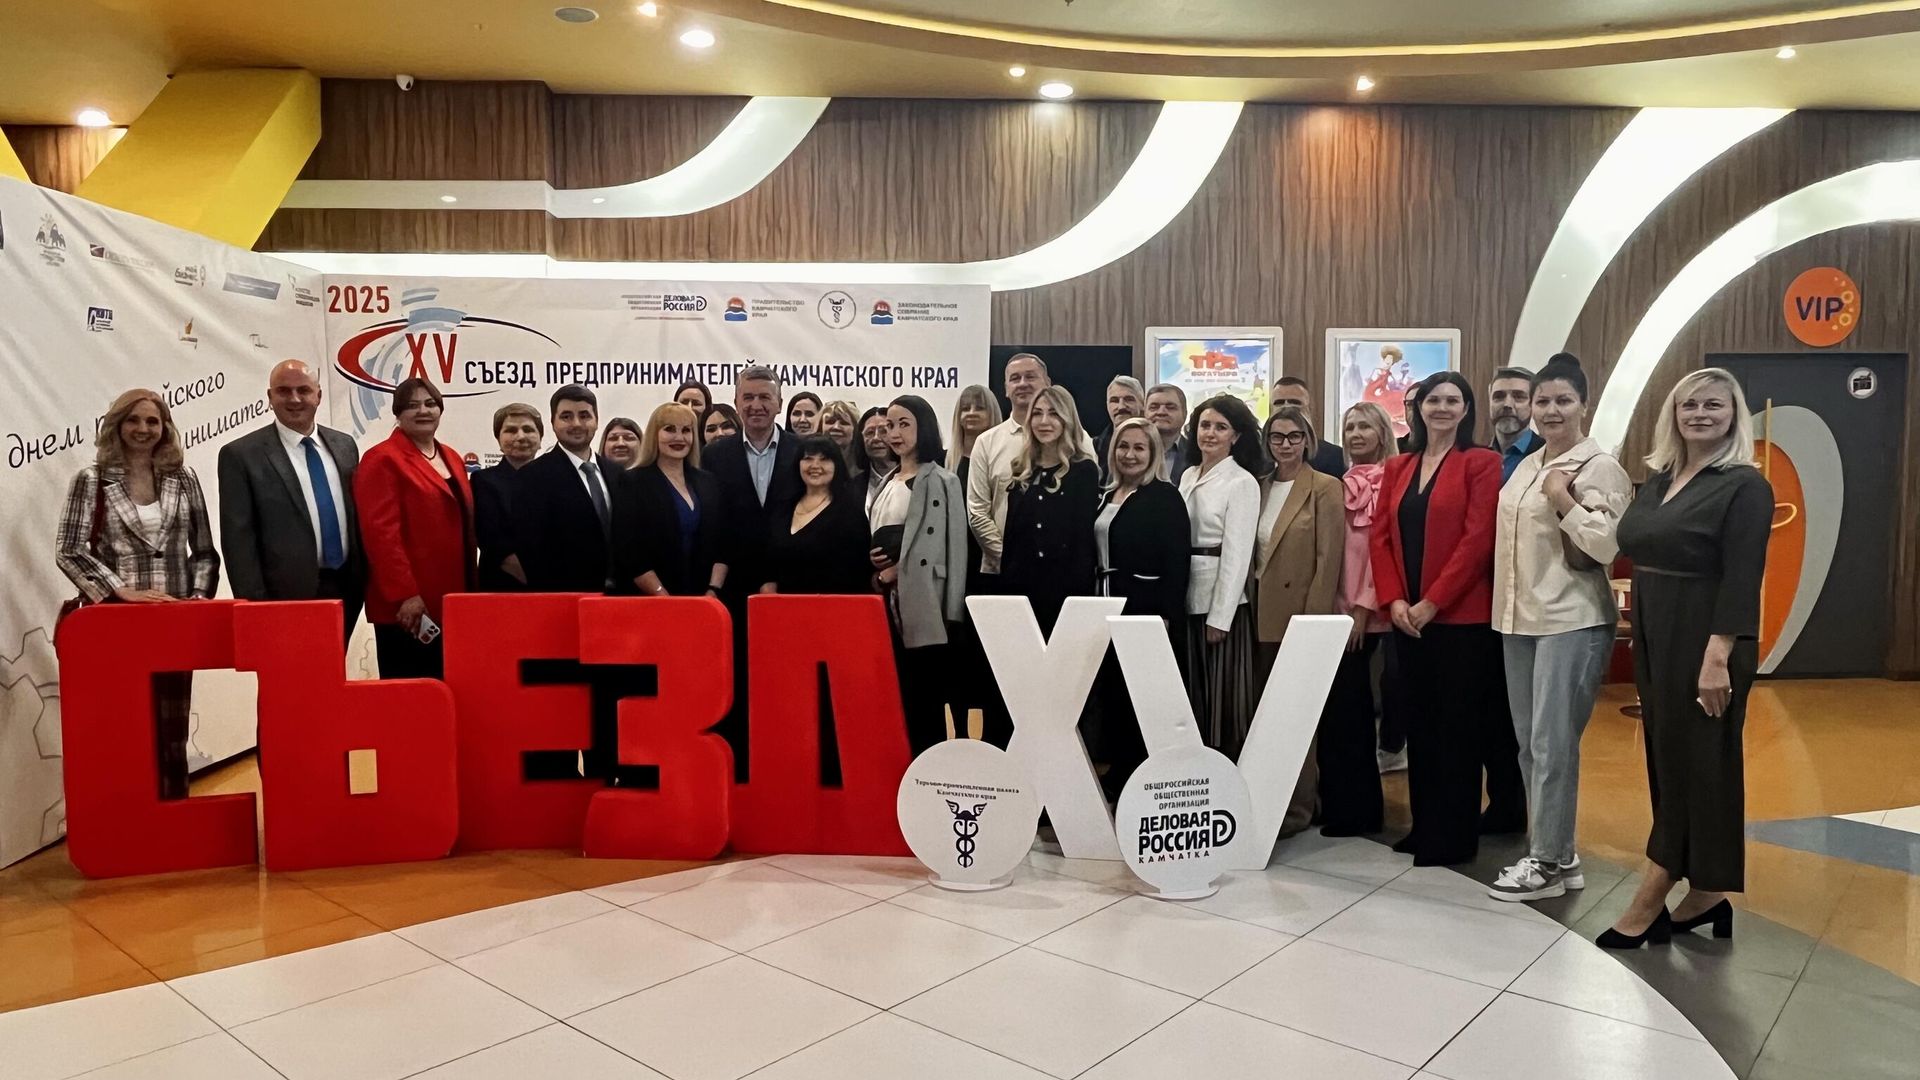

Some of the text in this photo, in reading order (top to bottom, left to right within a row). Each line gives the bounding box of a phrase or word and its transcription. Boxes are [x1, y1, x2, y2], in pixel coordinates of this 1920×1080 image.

[327, 285, 390, 313] 2025
[664, 302, 695, 311] РОССИЯ
[1796, 296, 1844, 322] VIP
[405, 333, 458, 384] XV
[465, 361, 536, 388] СЪЕЗД
[911, 367, 959, 389] КРАЯ
[6, 425, 84, 468] днем
[54, 592, 1355, 880] СЪЕЗД XV
[1144, 777, 1210, 791] ОБЩЕРОССИЙСКАЯ
[1153, 788, 1210, 800] ОБЩЕСТВЕННАЯ
[1158, 798, 1210, 810] ОРГАНИЗАЦИЯ
[1139, 810, 1210, 835] ДЕЛОВАЯ
[1138, 829, 1210, 856] РОССИЯ
[1138, 850, 1210, 864] КАМЧАТКА
